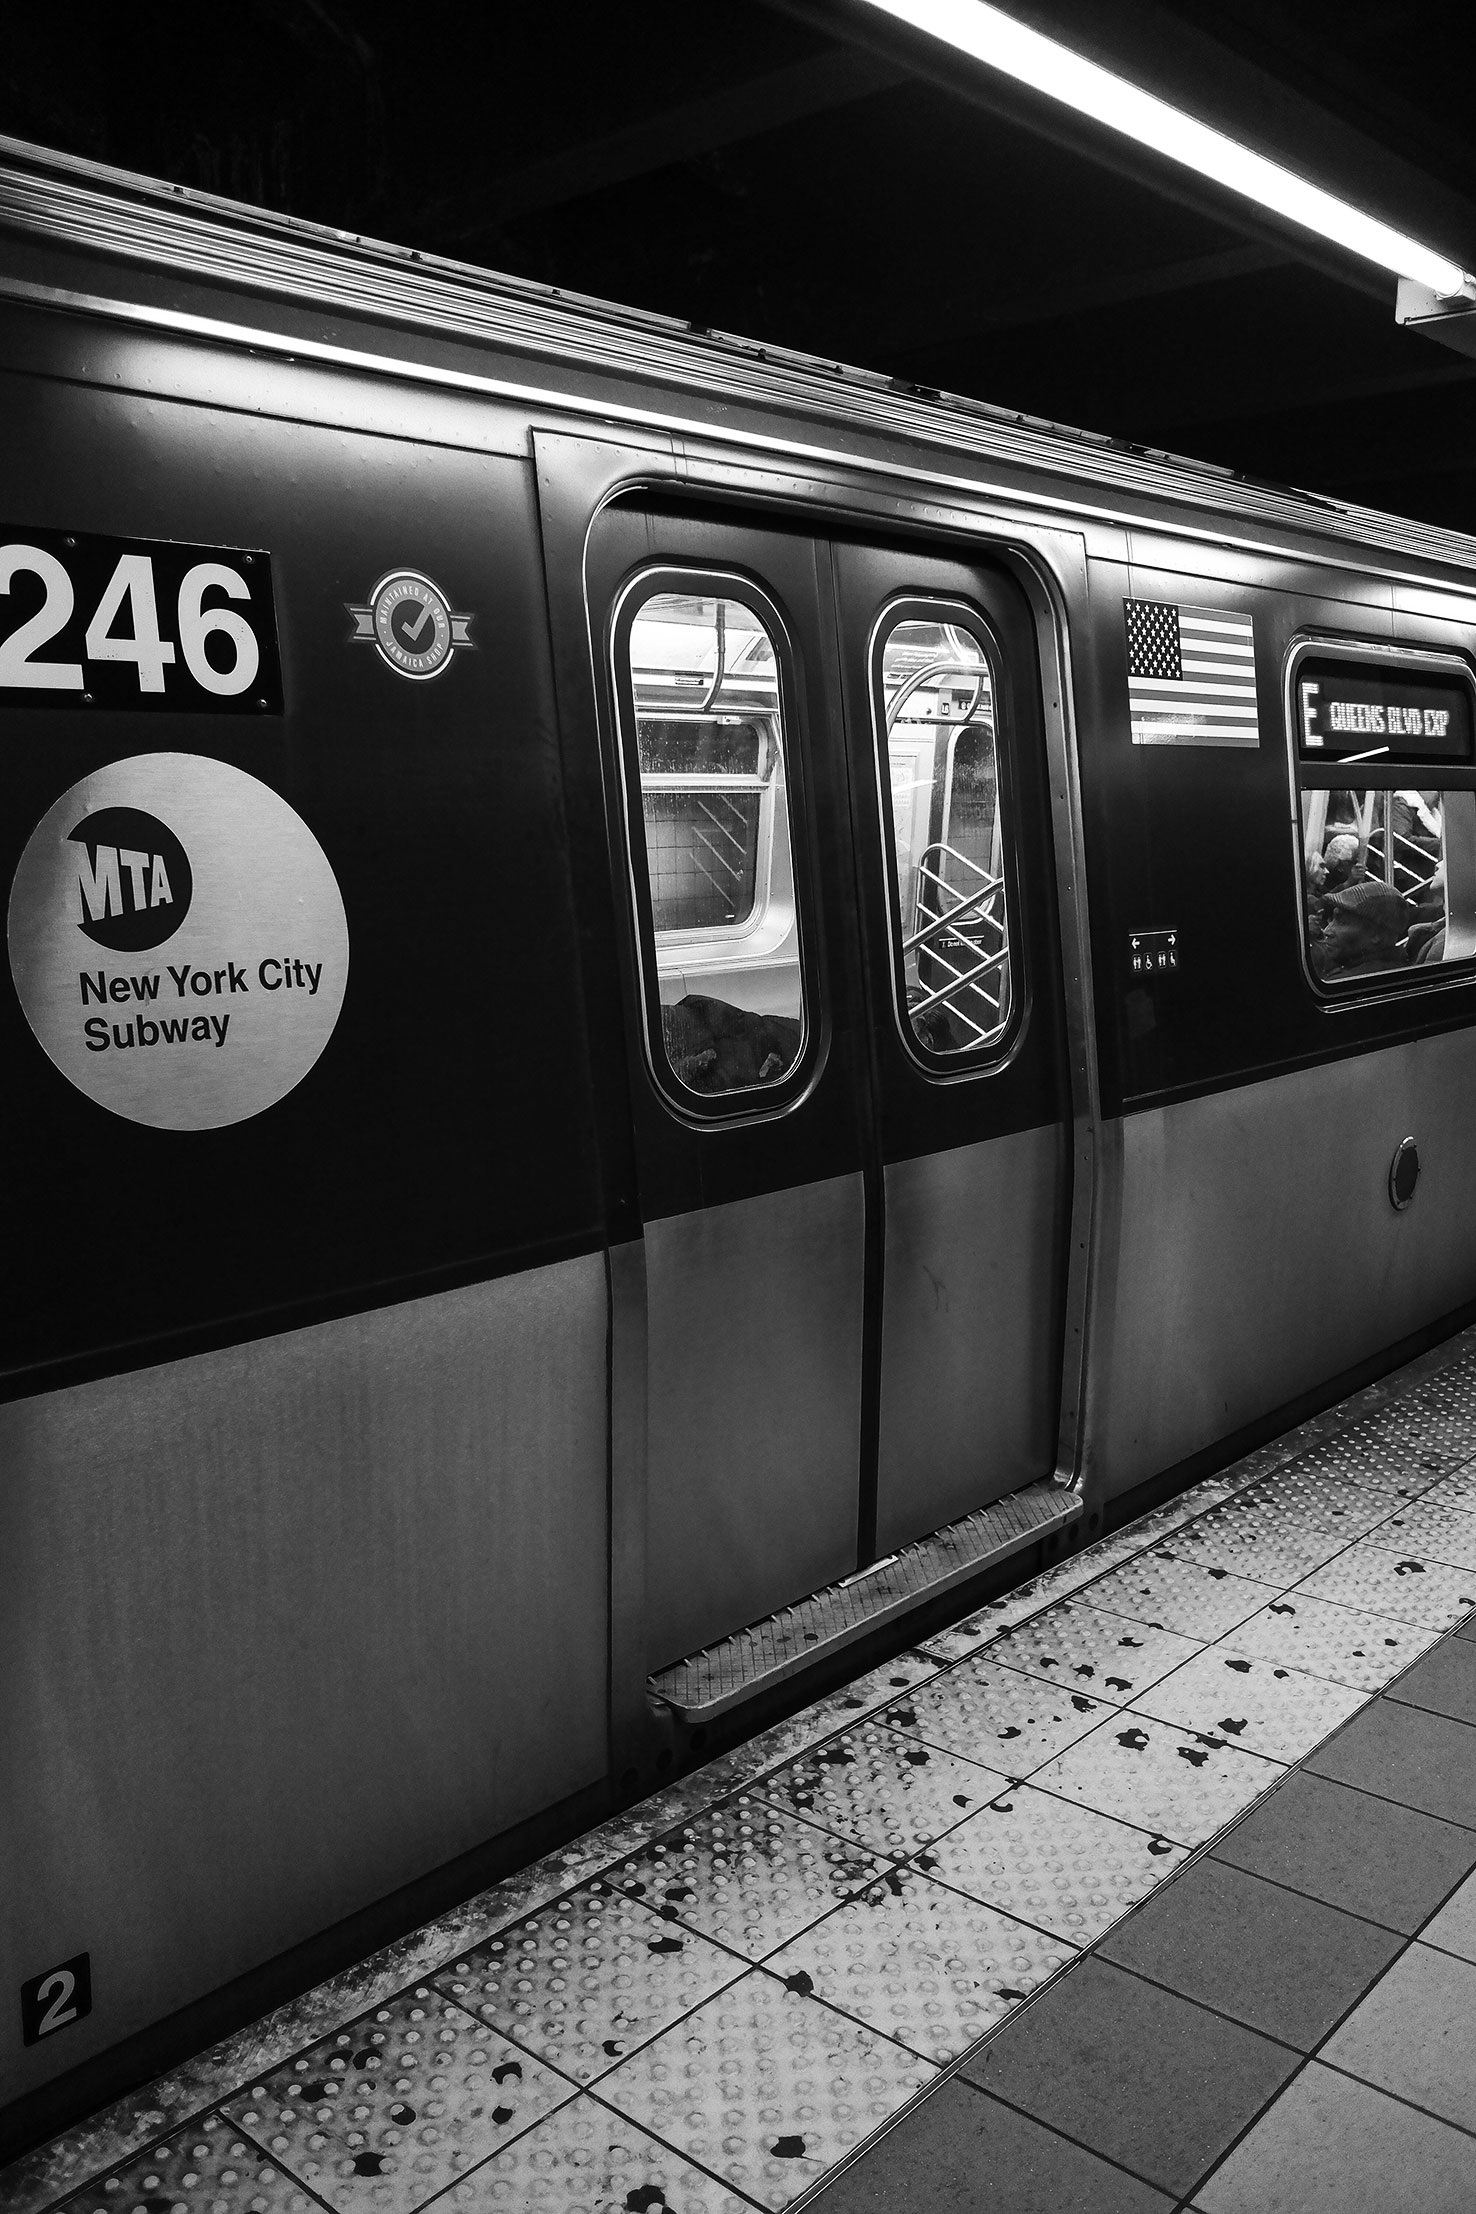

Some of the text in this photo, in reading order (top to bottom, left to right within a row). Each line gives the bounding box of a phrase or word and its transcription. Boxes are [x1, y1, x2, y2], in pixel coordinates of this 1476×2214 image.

[0, 544, 260, 696] 246
[379, 585, 446, 629] MAINTAINED AT OUR
[385, 641, 444, 668] JAMAICA SHOP
[1302, 682, 1325, 747] E
[1329, 702, 1450, 737] QUEENS BLVD EXP
[64, 838, 174, 925] MTA
[79, 957, 323, 1006] New York City
[84, 1013, 231, 1052] Subway
[37, 1969, 77, 2036] 2
